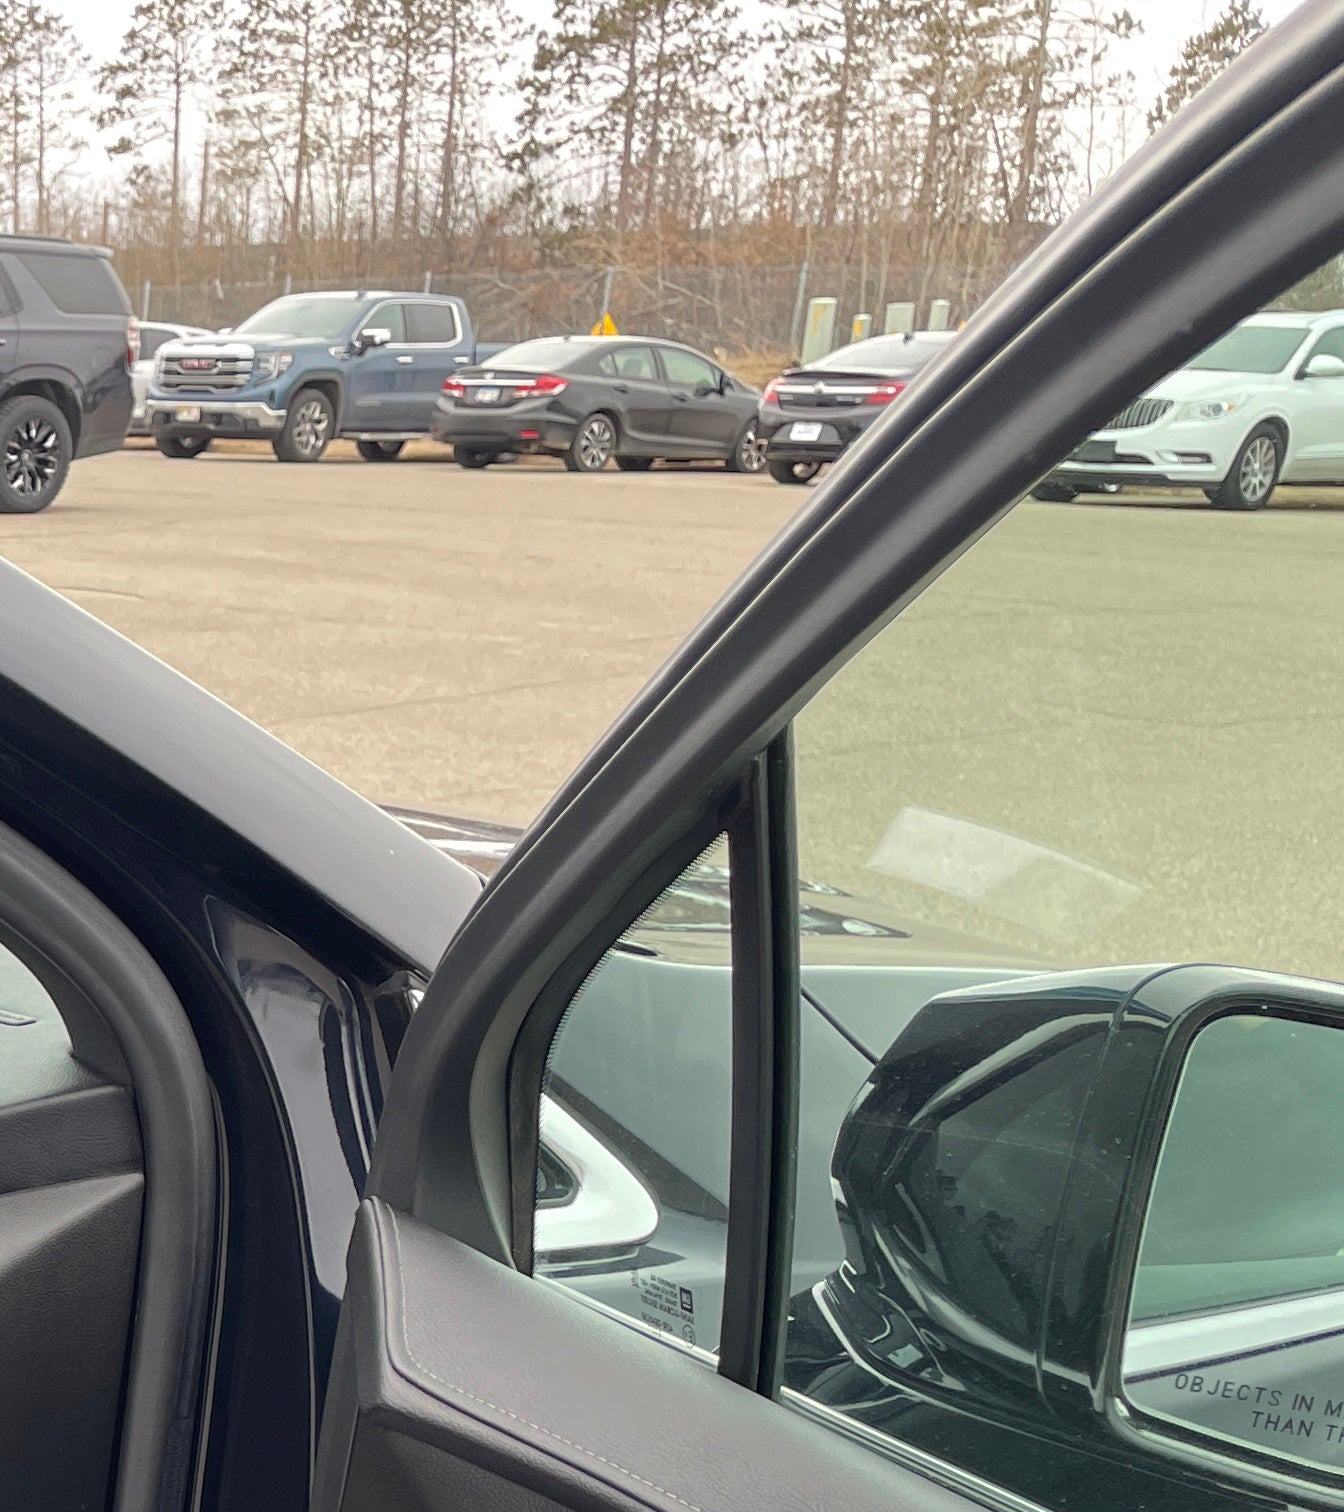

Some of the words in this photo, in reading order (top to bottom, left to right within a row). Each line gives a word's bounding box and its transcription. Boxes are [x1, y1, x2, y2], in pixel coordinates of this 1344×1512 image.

[1175, 1373, 1282, 1406] OBJECTS
[1292, 1393, 1314, 1412] IN
[1324, 1400, 1344, 1418] M
[1252, 1411, 1314, 1437] THAN
